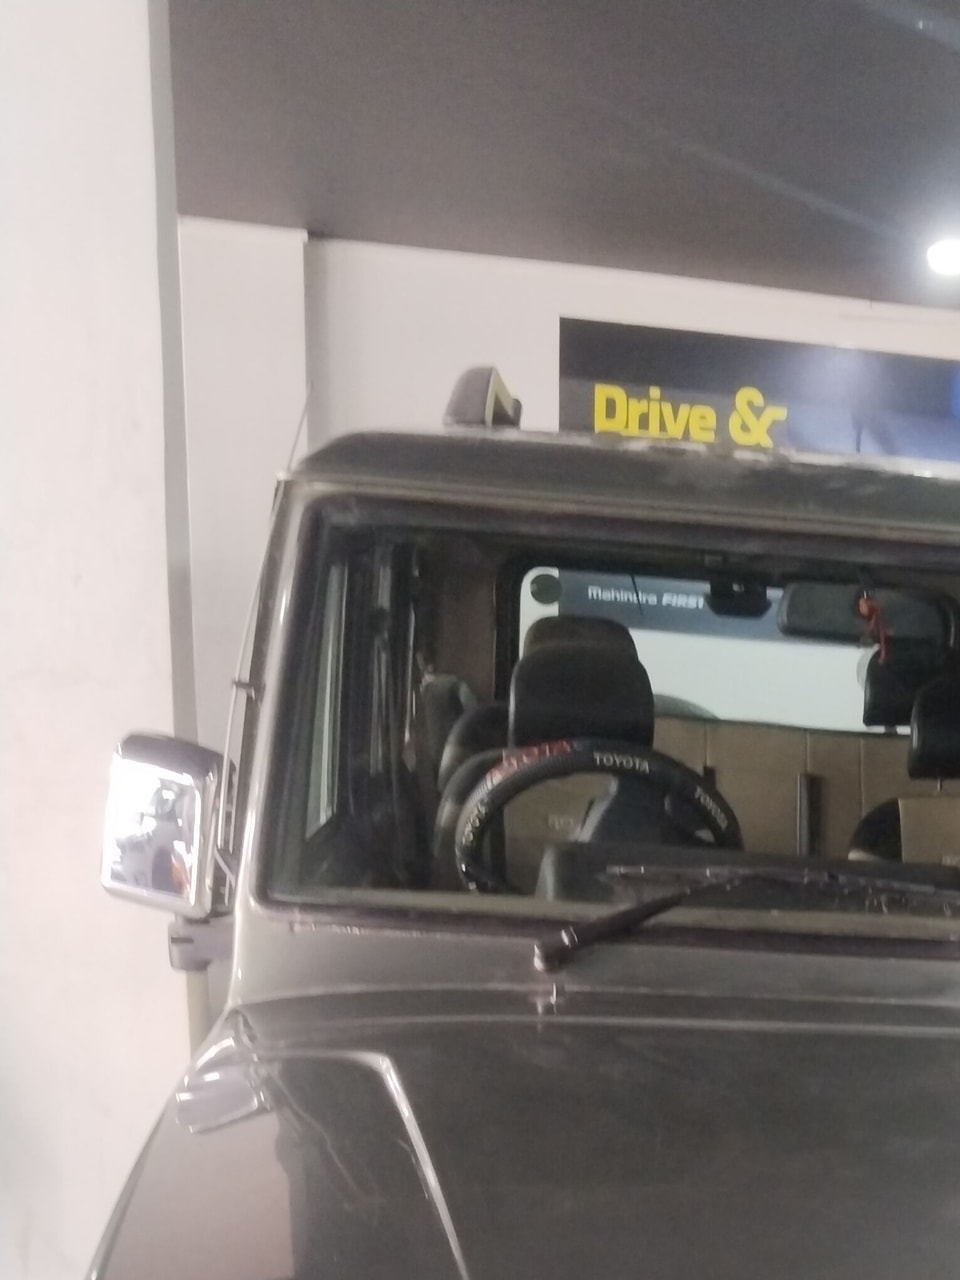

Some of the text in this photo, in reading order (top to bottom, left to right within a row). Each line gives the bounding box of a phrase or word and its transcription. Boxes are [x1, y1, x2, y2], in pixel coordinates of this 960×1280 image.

[594, 383, 787, 448] Drive &
[594, 751, 650, 774] TOYOTA
